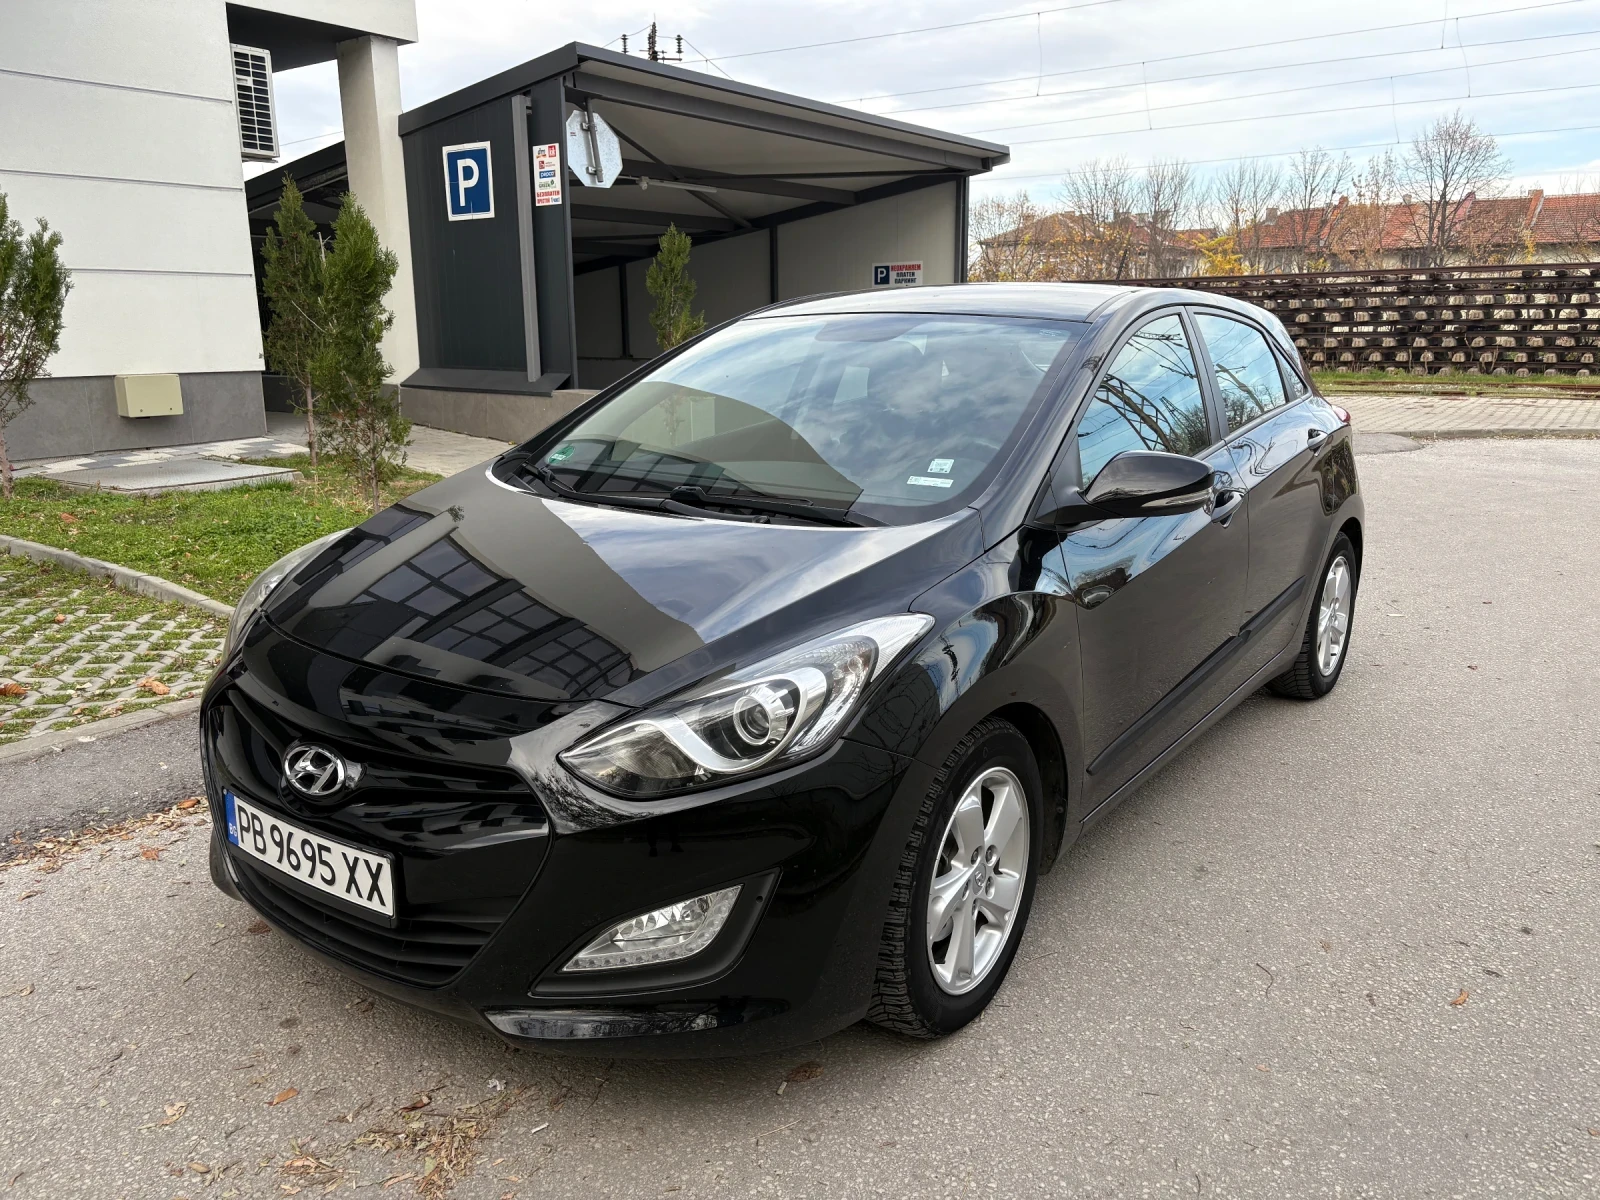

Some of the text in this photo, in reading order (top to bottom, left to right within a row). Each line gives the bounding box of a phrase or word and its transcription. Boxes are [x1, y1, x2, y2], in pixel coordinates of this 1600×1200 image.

[457, 158, 479, 206] P
[878, 268, 886, 283] P
[229, 823, 238, 837] BG
[238, 804, 387, 907] PB 9695 XX
